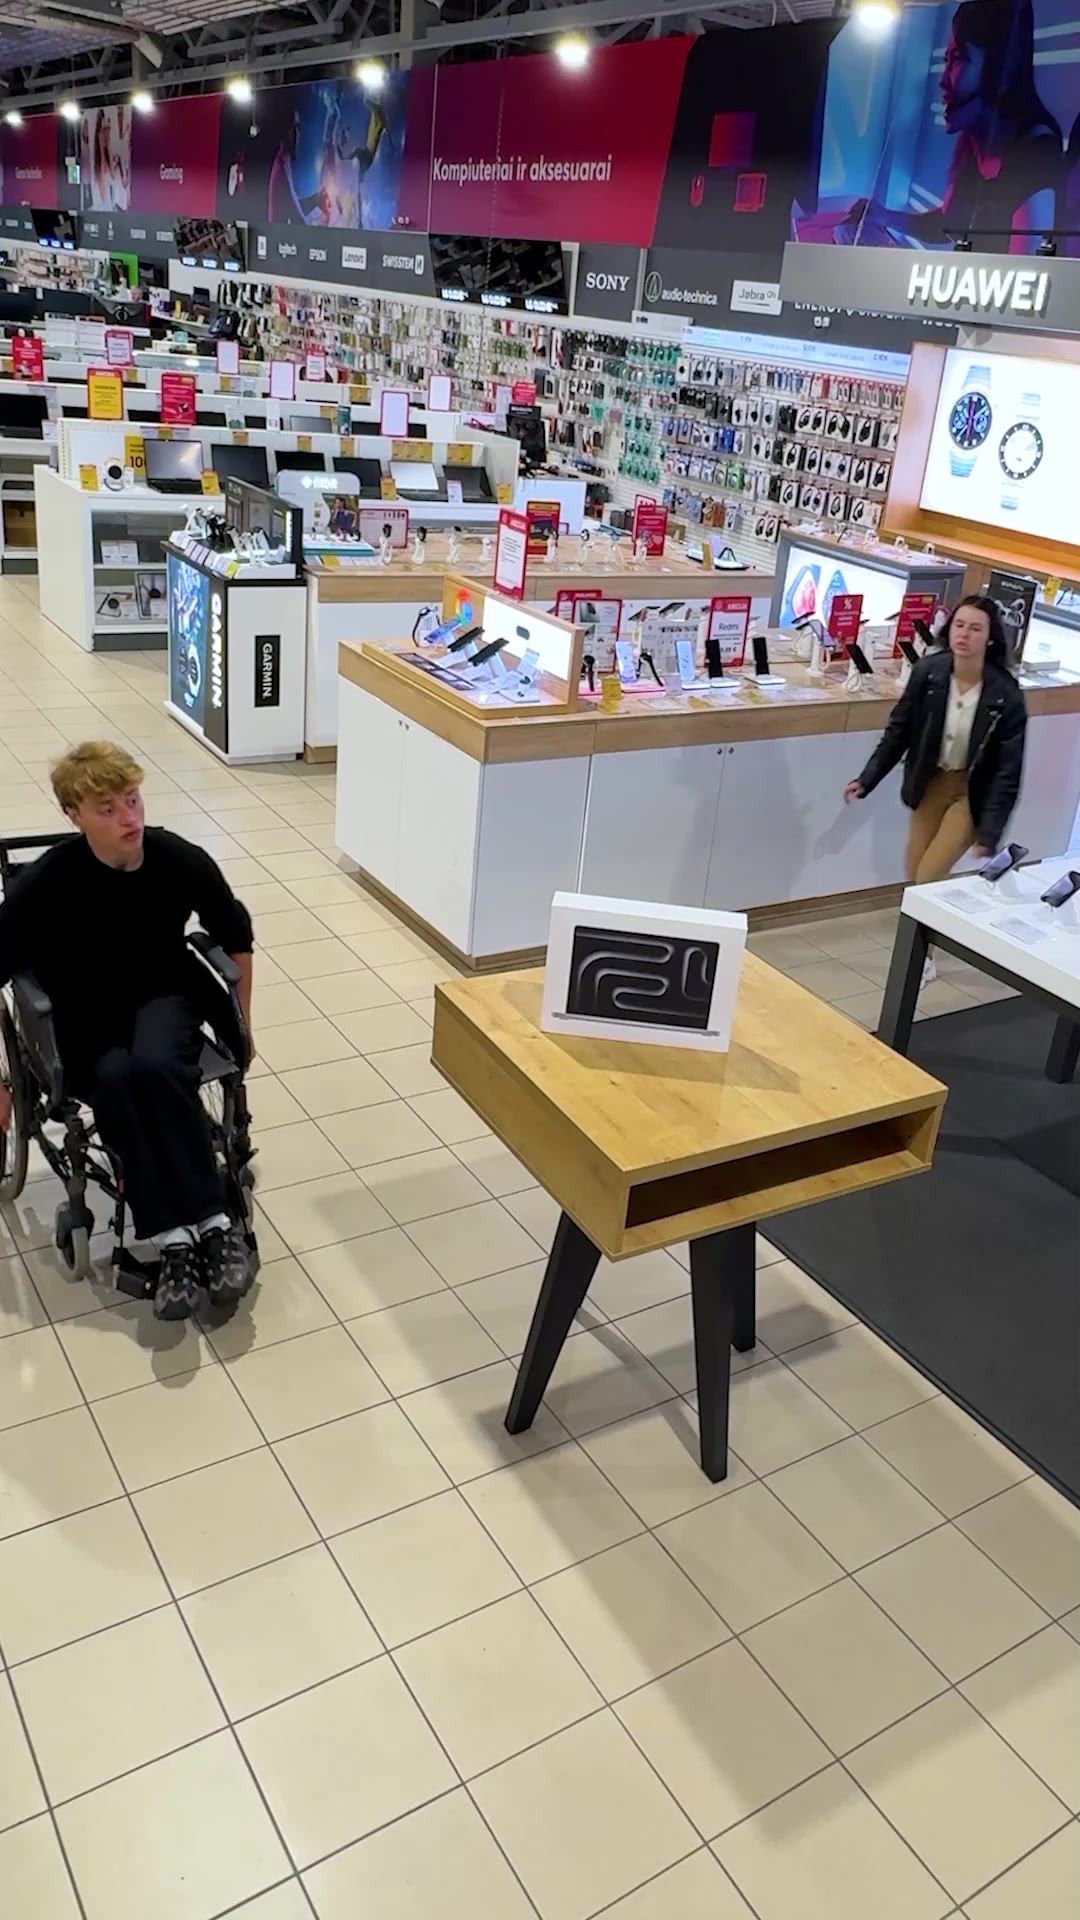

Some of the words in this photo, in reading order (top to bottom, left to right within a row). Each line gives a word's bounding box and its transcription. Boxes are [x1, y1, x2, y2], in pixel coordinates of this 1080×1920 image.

[159, 163, 184, 184] Gaming
[432, 156, 513, 187] Kompiuteriai
[516, 156, 527, 181] ir
[529, 154, 612, 181] aksesuarai
[309, 248, 327, 261] EPSON
[344, 251, 365, 264] Lenovo
[585, 272, 630, 292] SONY
[907, 264, 1049, 312] HUAWEI
[661, 288, 719, 306] audio-technica
[738, 288, 766, 301] Jabra
[211, 593, 222, 708] GARMIN
[262, 642, 273, 699] GARMIN
